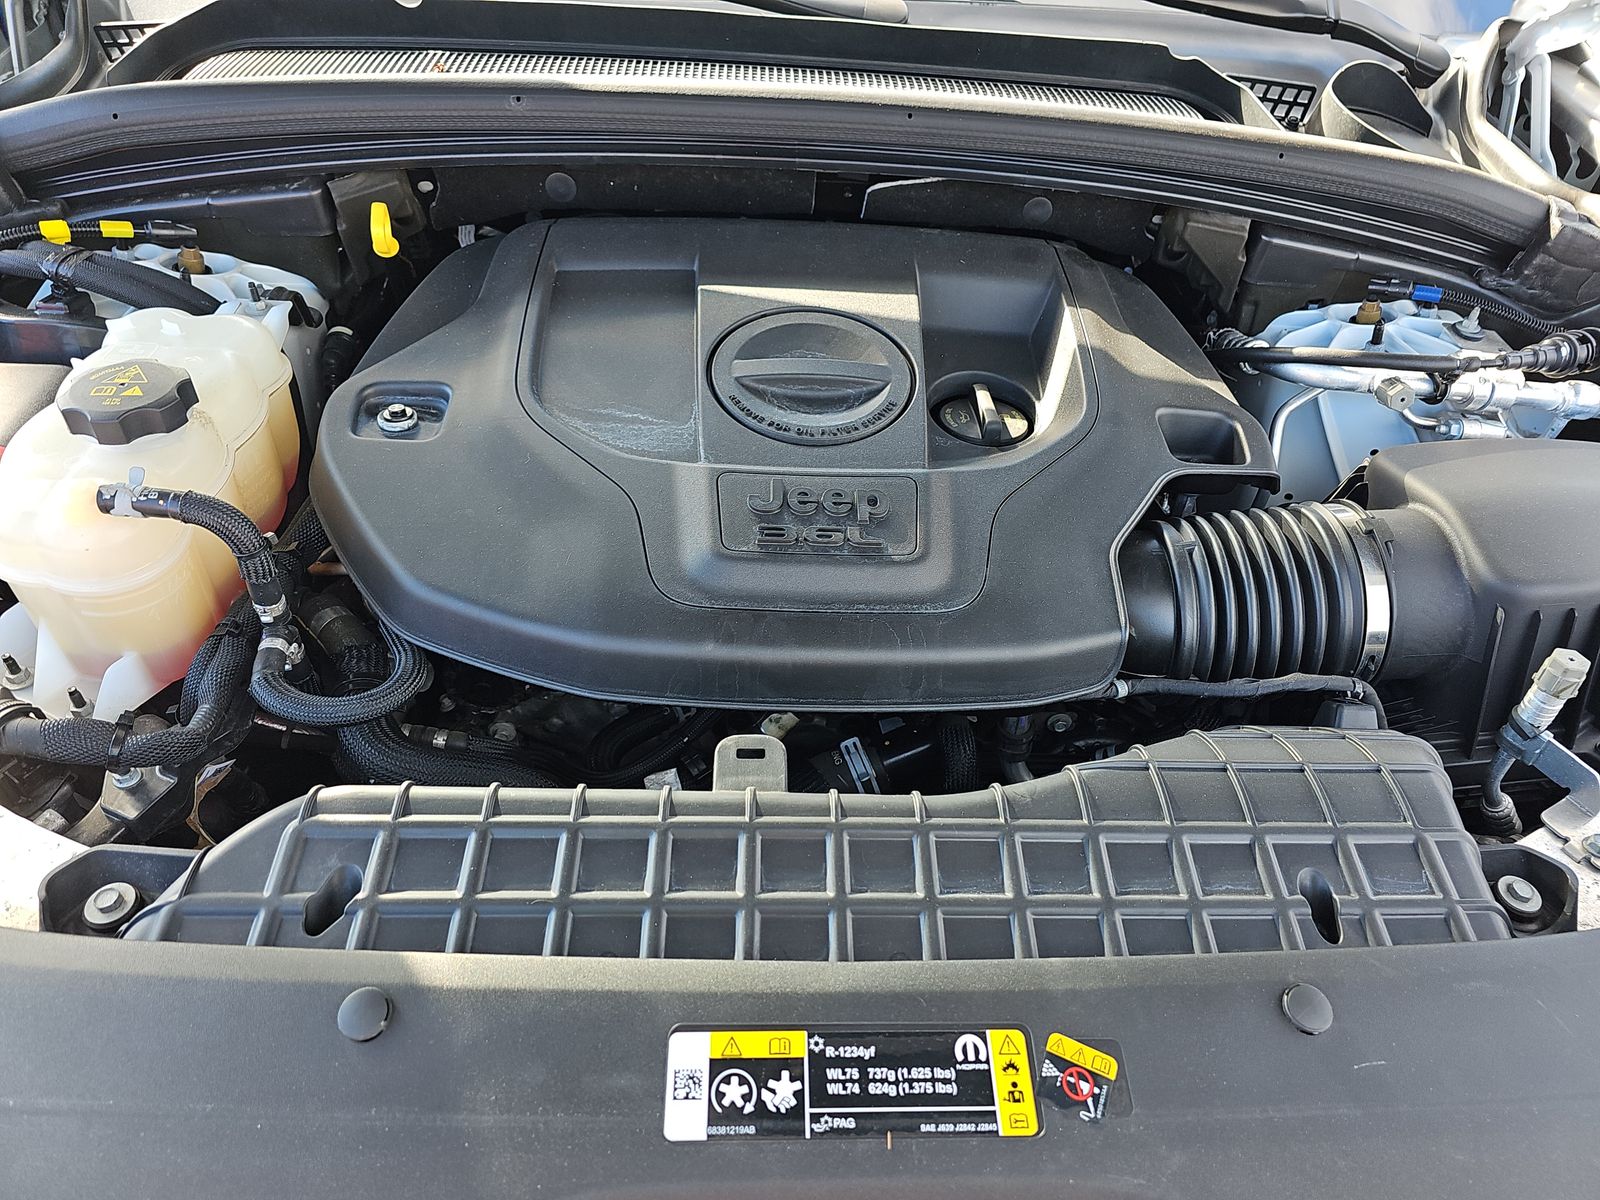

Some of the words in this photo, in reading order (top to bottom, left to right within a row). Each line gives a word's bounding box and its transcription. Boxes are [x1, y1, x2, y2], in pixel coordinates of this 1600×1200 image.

[728, 394, 766, 424] REMOVE
[767, 419, 791, 434] FOR
[795, 427, 815, 438] OIL
[820, 425, 860, 438] FILTER
[860, 400, 898, 429] SERVICE
[747, 478, 891, 526] Jeep
[755, 525, 883, 548] 3.6L
[825, 1046, 876, 1060] R-1234yf
[825, 1067, 860, 1080] WL75
[867, 1067, 896, 1082] 737g
[897, 1066, 932, 1081] (1.625
[933, 1066, 957, 1081] lbs)
[826, 1082, 861, 1095] WL74
[868, 1082, 898, 1097] 624g
[898, 1082, 934, 1096] (1.375
[934, 1081, 958, 1096] lbs)
[707, 1125, 757, 1135] 68381219AB
[833, 1117, 857, 1129] PAG
[937, 1123, 955, 1132] J639
